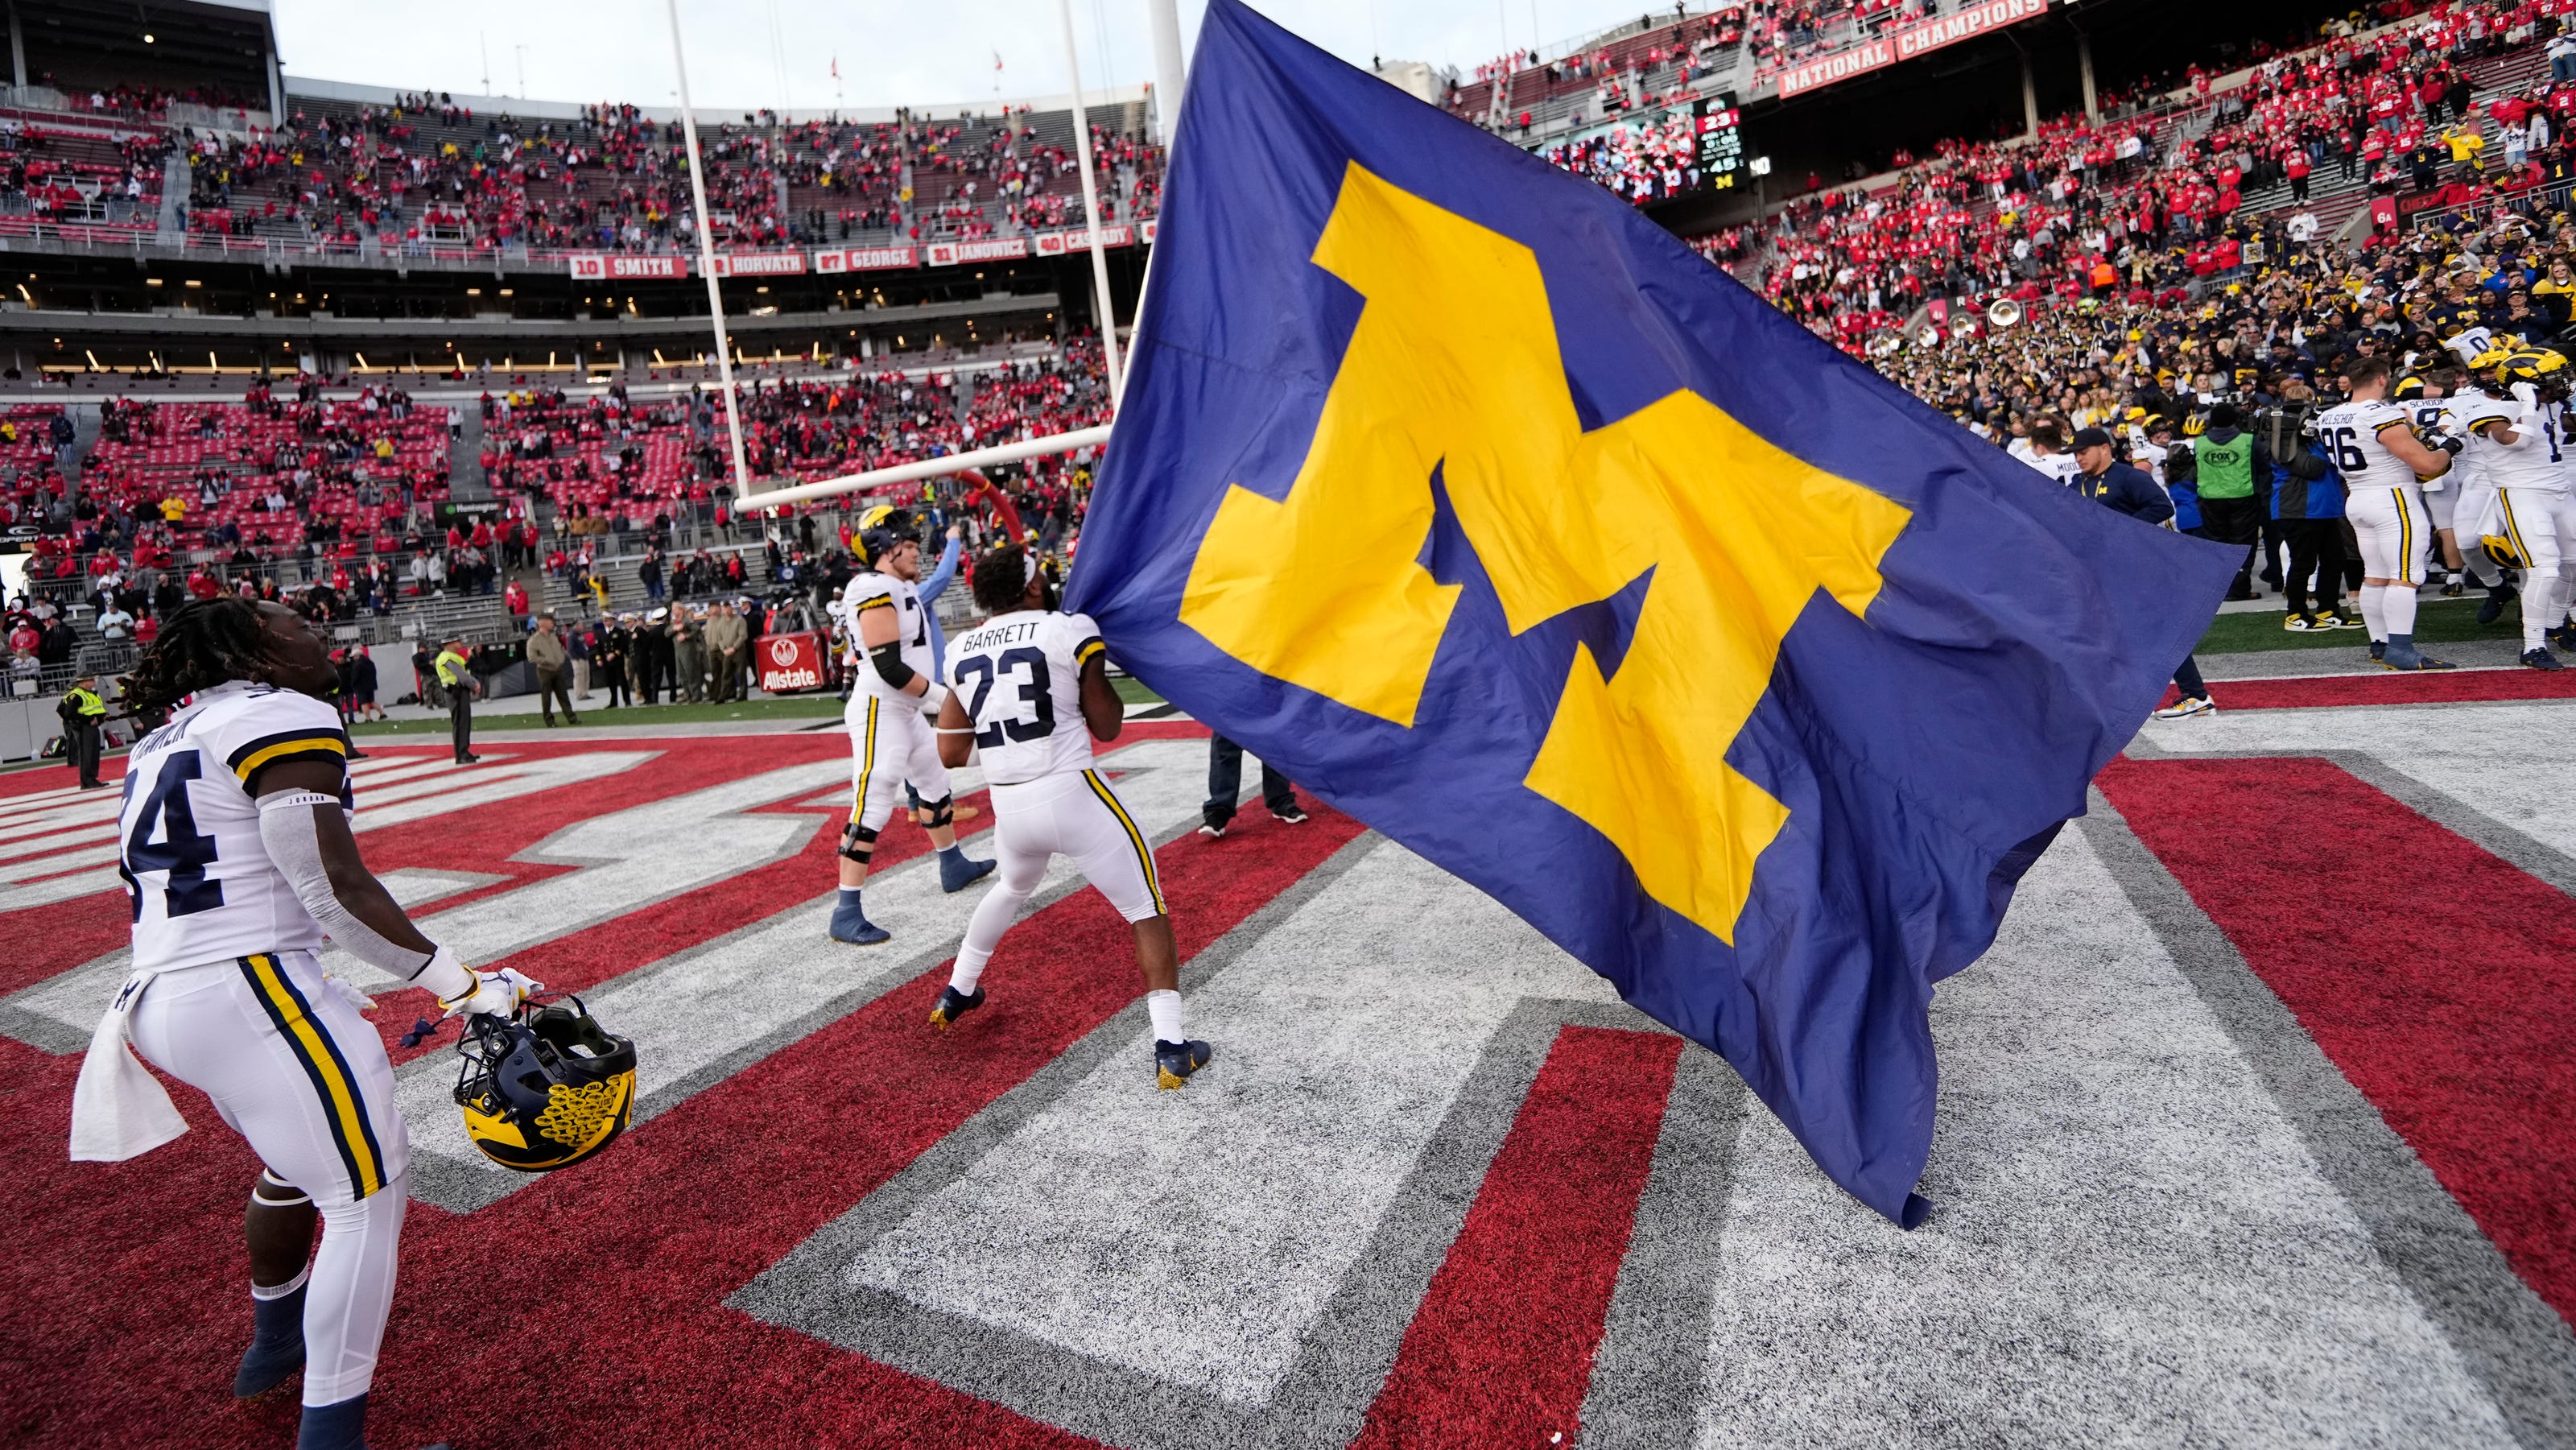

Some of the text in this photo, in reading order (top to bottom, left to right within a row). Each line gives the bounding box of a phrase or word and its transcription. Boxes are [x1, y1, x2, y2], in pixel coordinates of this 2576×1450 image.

[1784, 0, 2041, 93] NATIONAL CHAMPIONS
[1703, 113, 1731, 130] 23
[1709, 157, 1737, 173] 45
[1749, 156, 1771, 175] 40
[2376, 212, 2392, 224] 6A
[1066, 228, 1128, 250] CASADY
[821, 248, 910, 270] 27 GEORGE
[957, 239, 1026, 260] JANOWICZ
[577, 257, 675, 276] 10 SMITH
[732, 254, 802, 274] HORVATH
[2211, 452, 2231, 463] FOX
[1179, 159, 1914, 948] M
[963, 622, 1040, 653] BARRETT
[763, 667, 816, 691] Allstate
[954, 646, 1056, 750] 23
[290, 795, 324, 804] JORDAN
